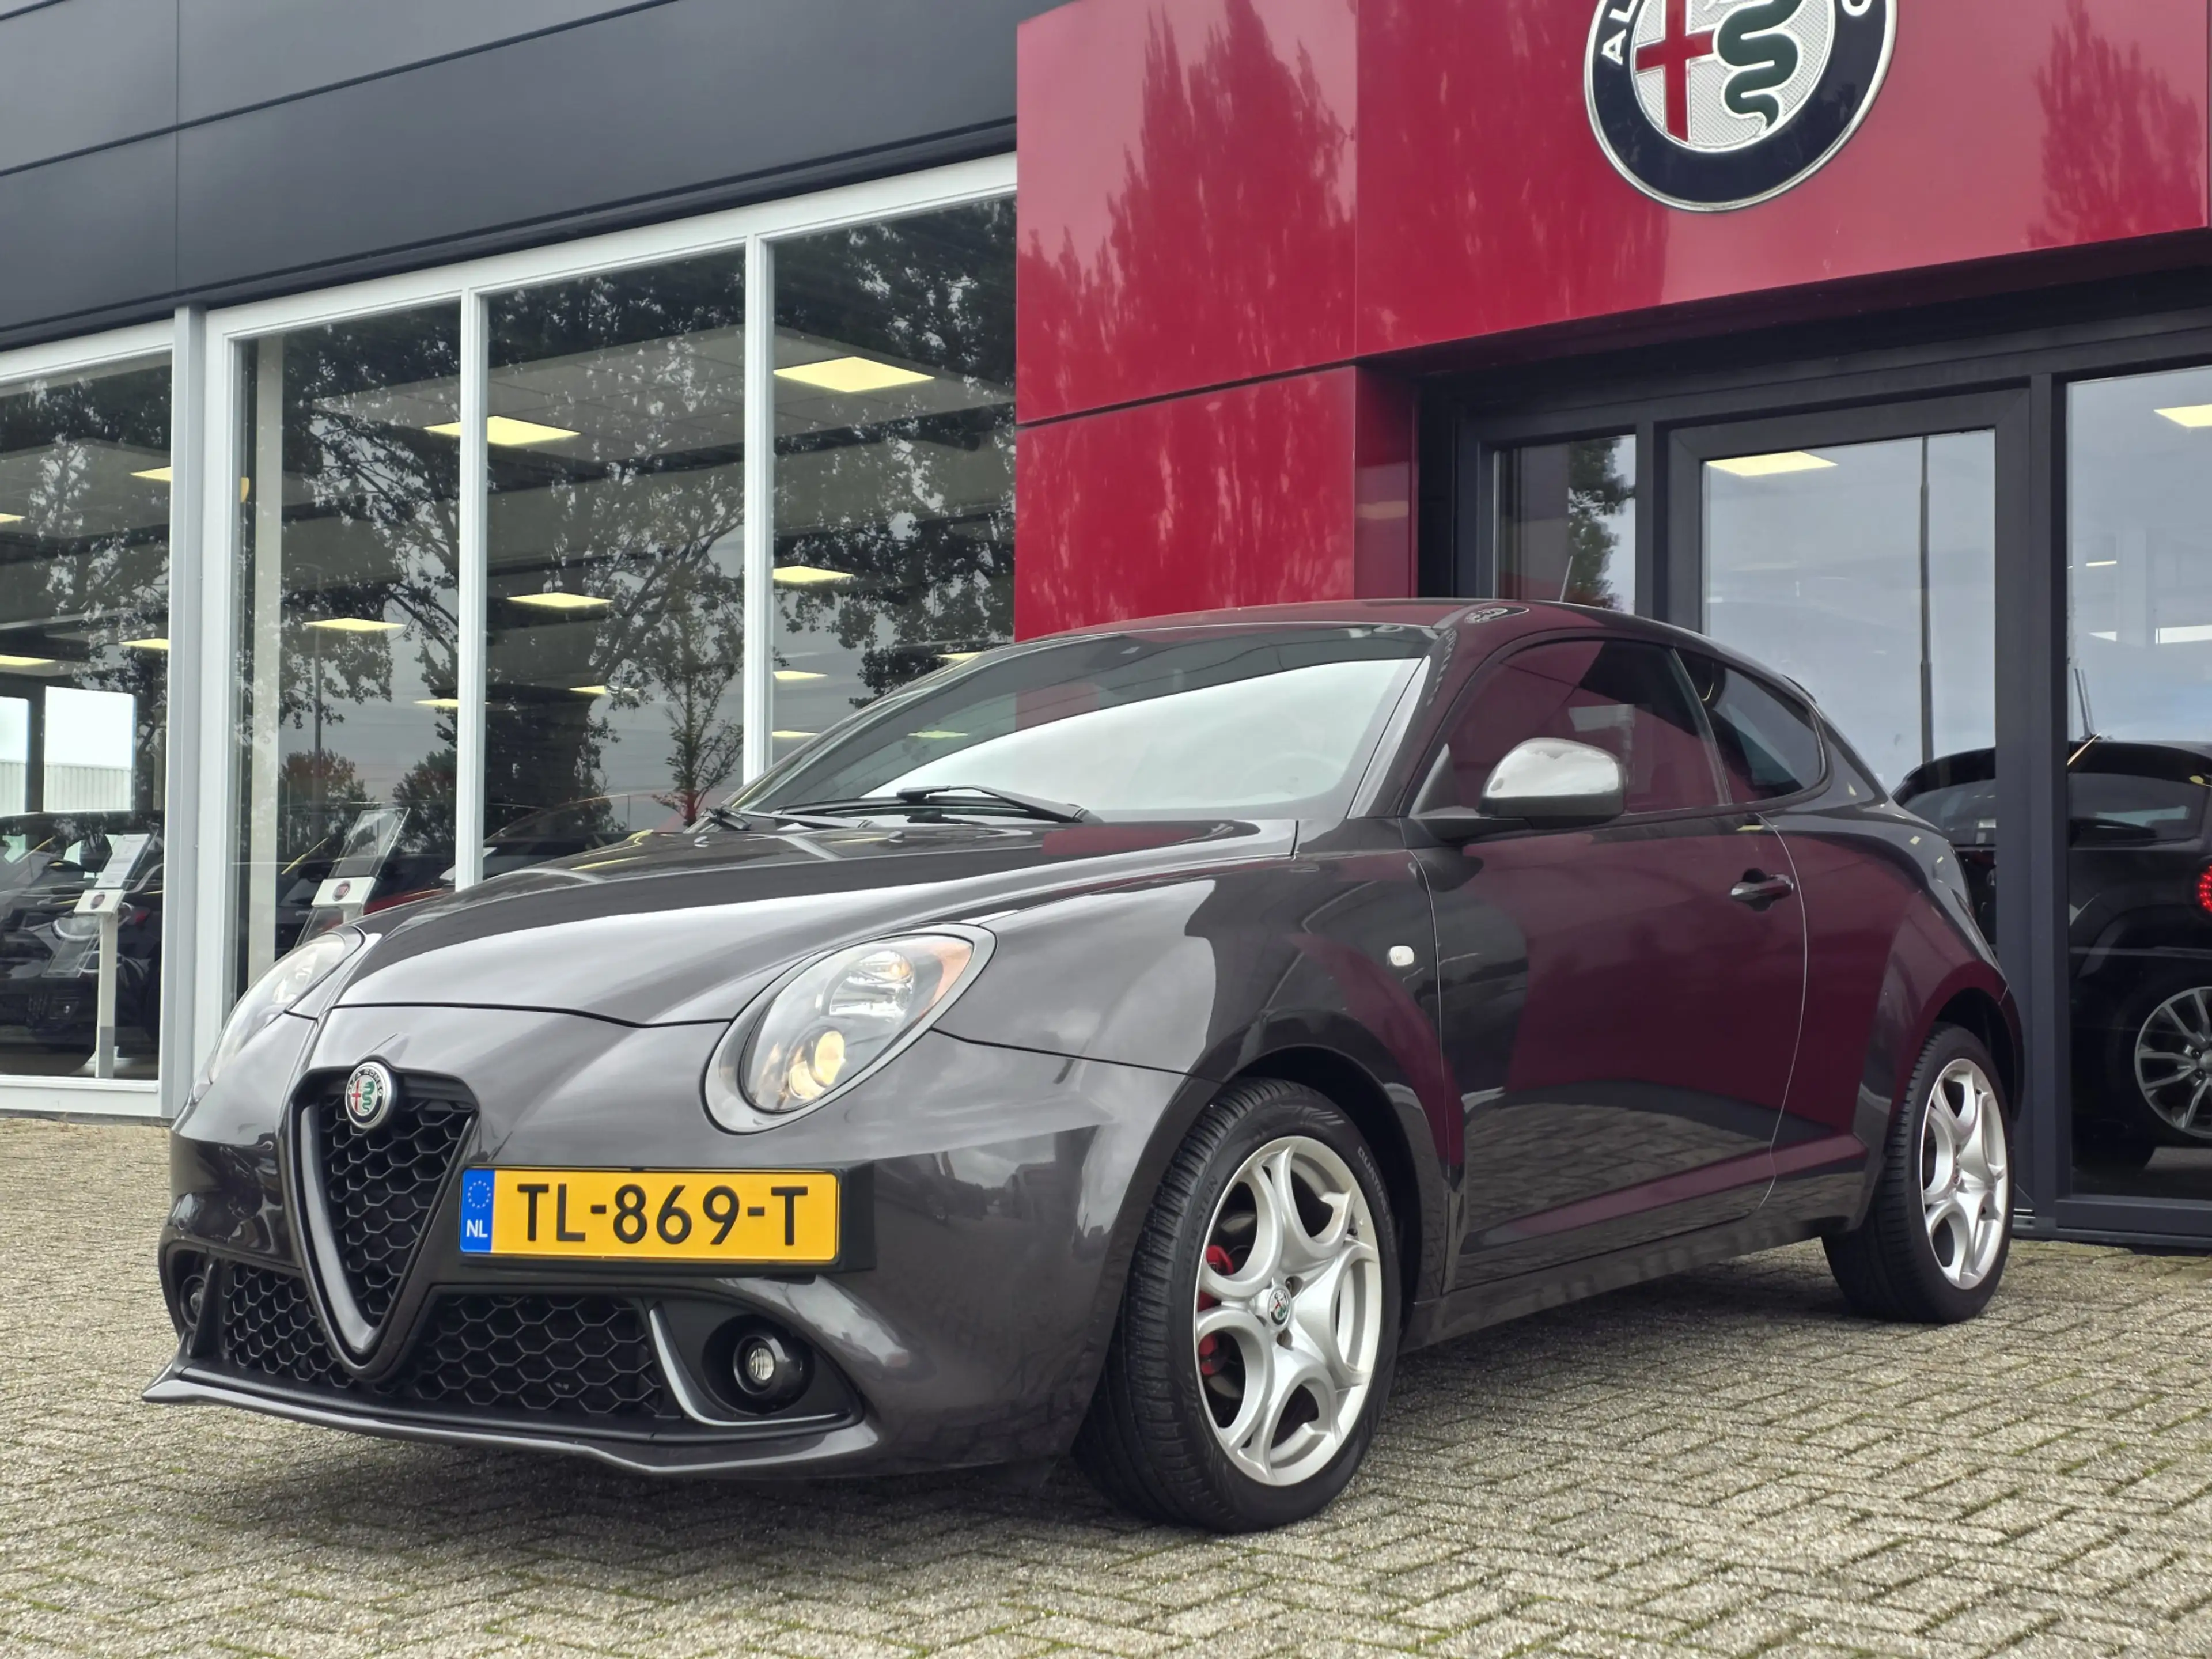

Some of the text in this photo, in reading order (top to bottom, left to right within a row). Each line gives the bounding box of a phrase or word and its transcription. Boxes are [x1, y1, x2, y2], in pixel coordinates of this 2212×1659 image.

[347, 1072, 361, 1095] ALA
[517, 1183, 808, 1247] TL-869-T
[466, 1219, 488, 1238] NL
